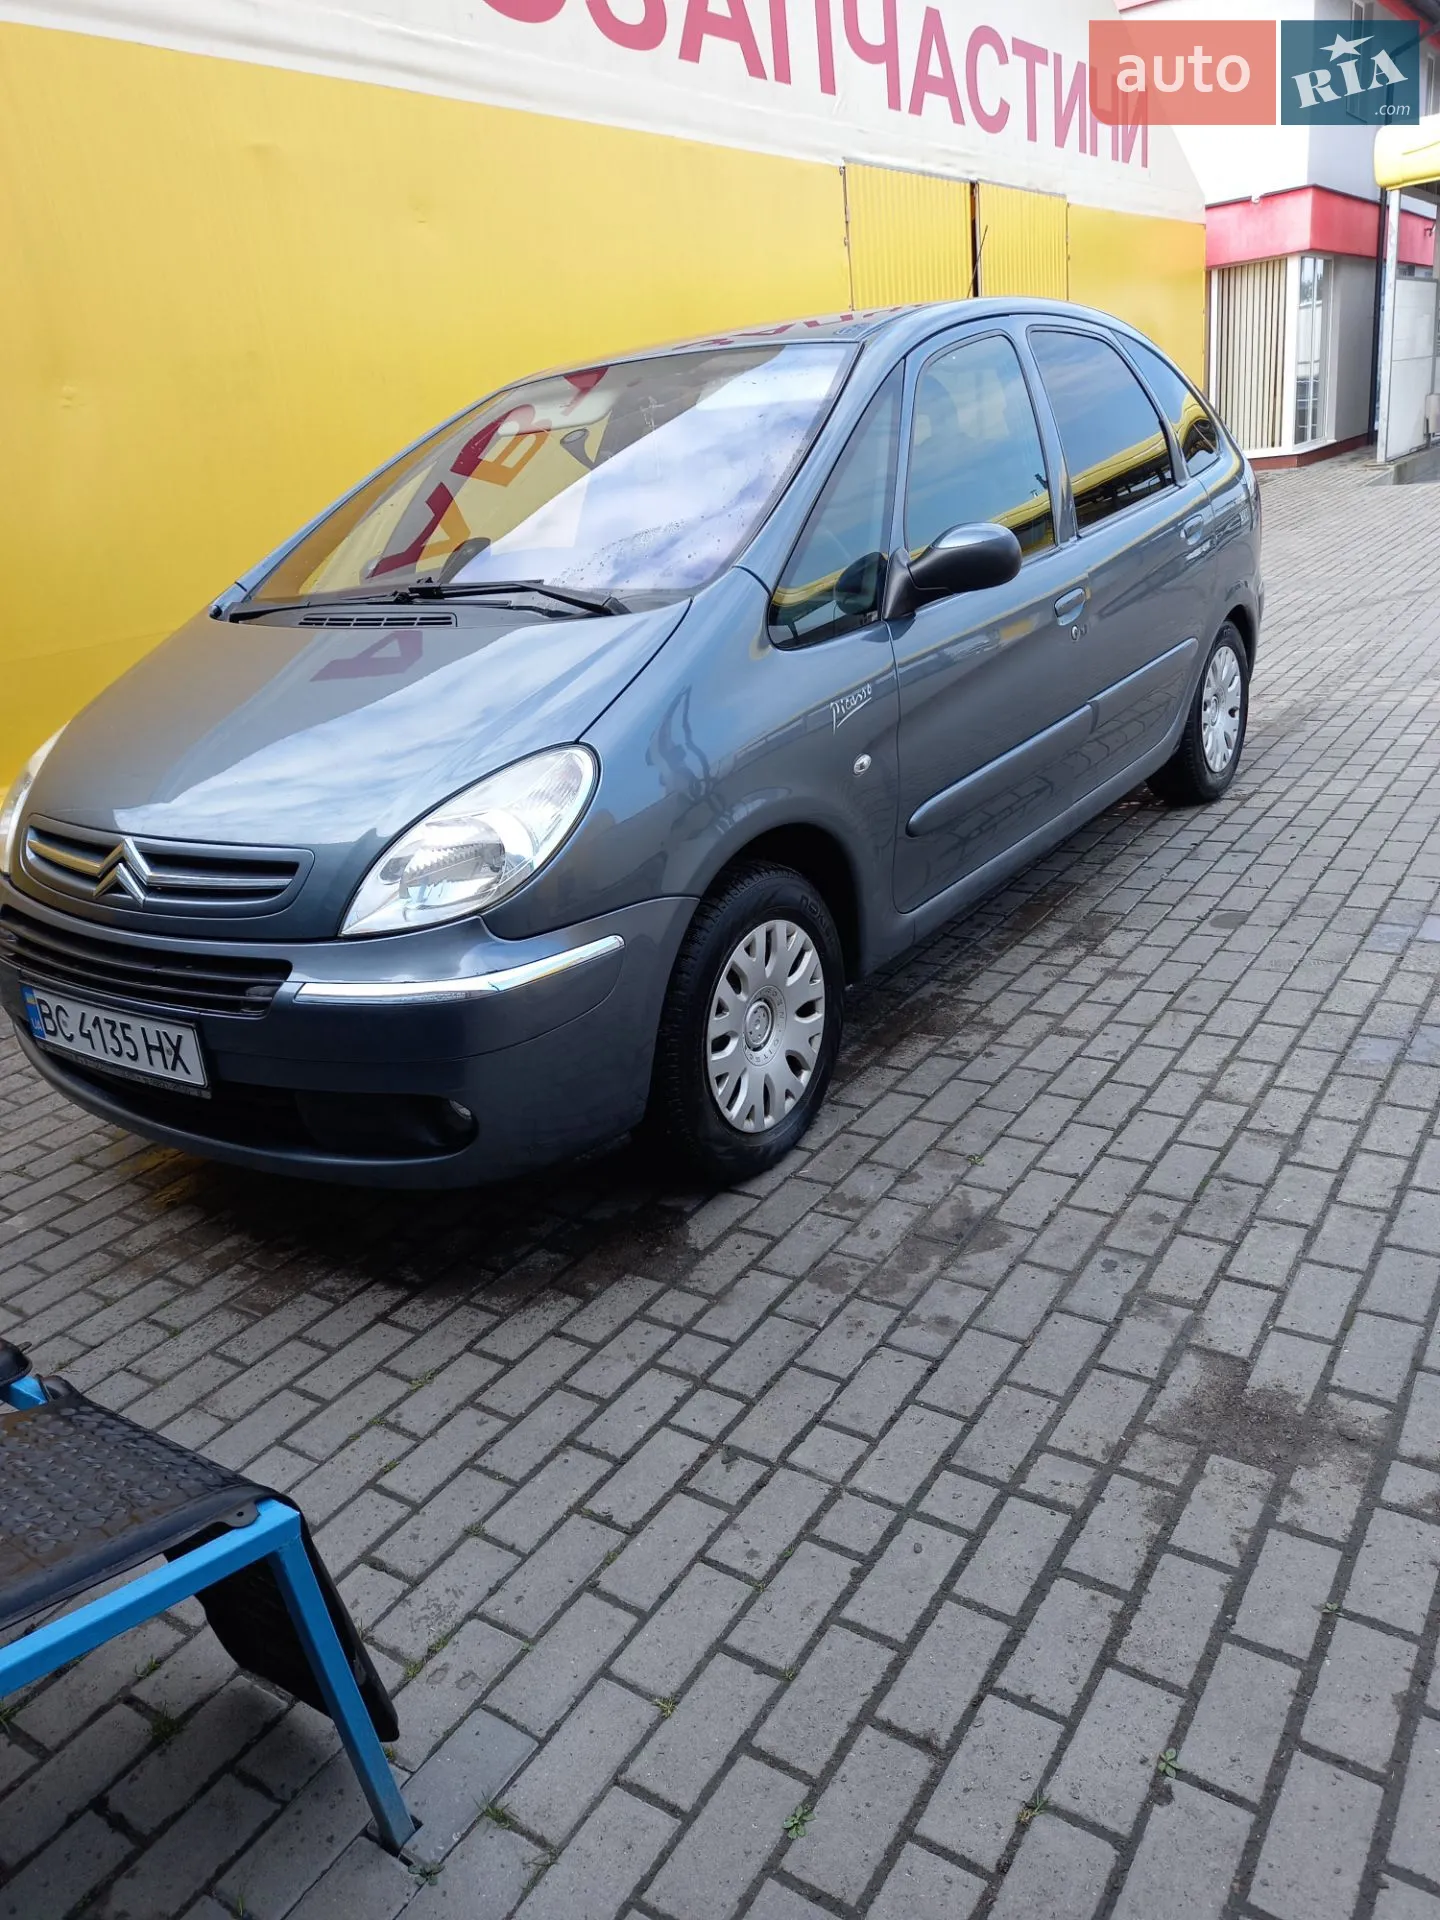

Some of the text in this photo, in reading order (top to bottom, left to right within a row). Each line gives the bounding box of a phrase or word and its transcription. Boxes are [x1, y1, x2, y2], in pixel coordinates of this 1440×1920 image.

[829, 683, 872, 735] Picasso
[36, 998, 191, 1075] BC 4135 HX
